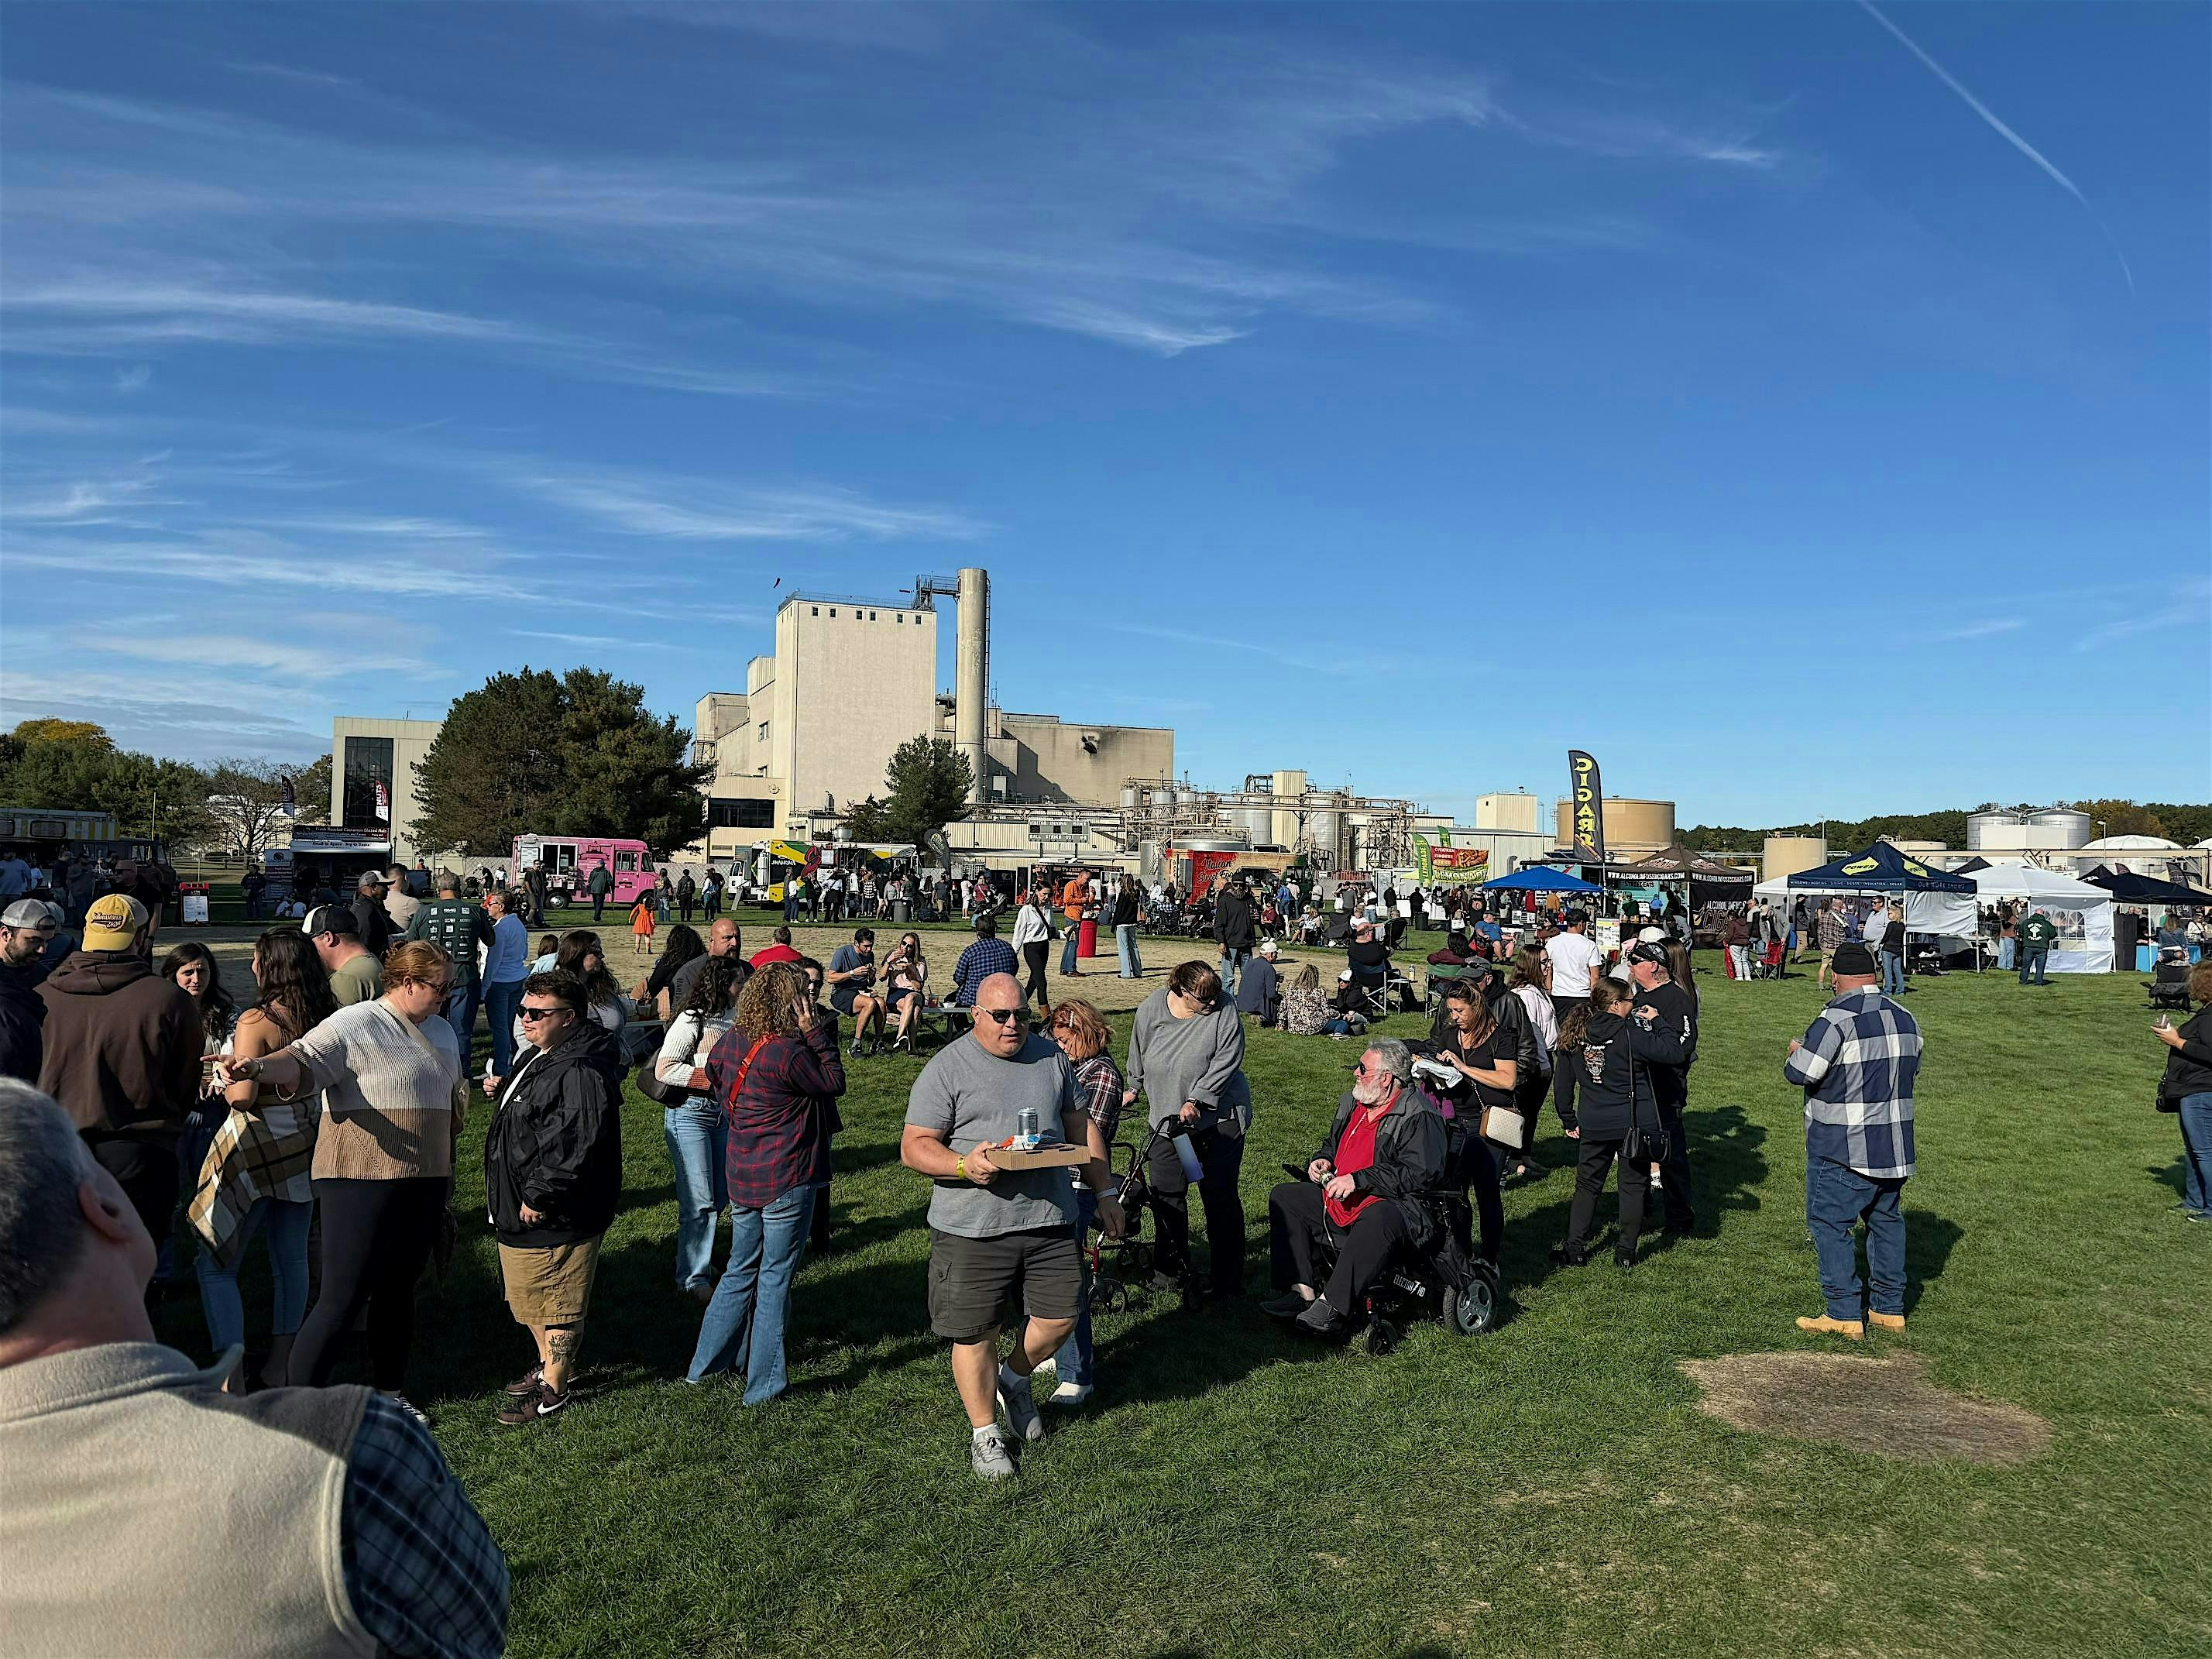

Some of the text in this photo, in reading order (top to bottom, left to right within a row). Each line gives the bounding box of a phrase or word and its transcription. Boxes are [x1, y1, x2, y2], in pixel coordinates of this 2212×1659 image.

[1202, 856, 1232, 871] Italian
[1420, 846, 1428, 877] LEMONADE
[1197, 871, 1218, 883] Street
[1607, 871, 1685, 880] WWW.ALCOHOLINFUSEDCIGARS.COM
[1692, 872, 1753, 883] WWW.ALCOHOLINFUSEDCIGARS.COM
[1706, 901, 1727, 910] ALCOHOL
[1393, 1274, 1414, 1292] ELECTRA
[1417, 1286, 1426, 1297] HD
